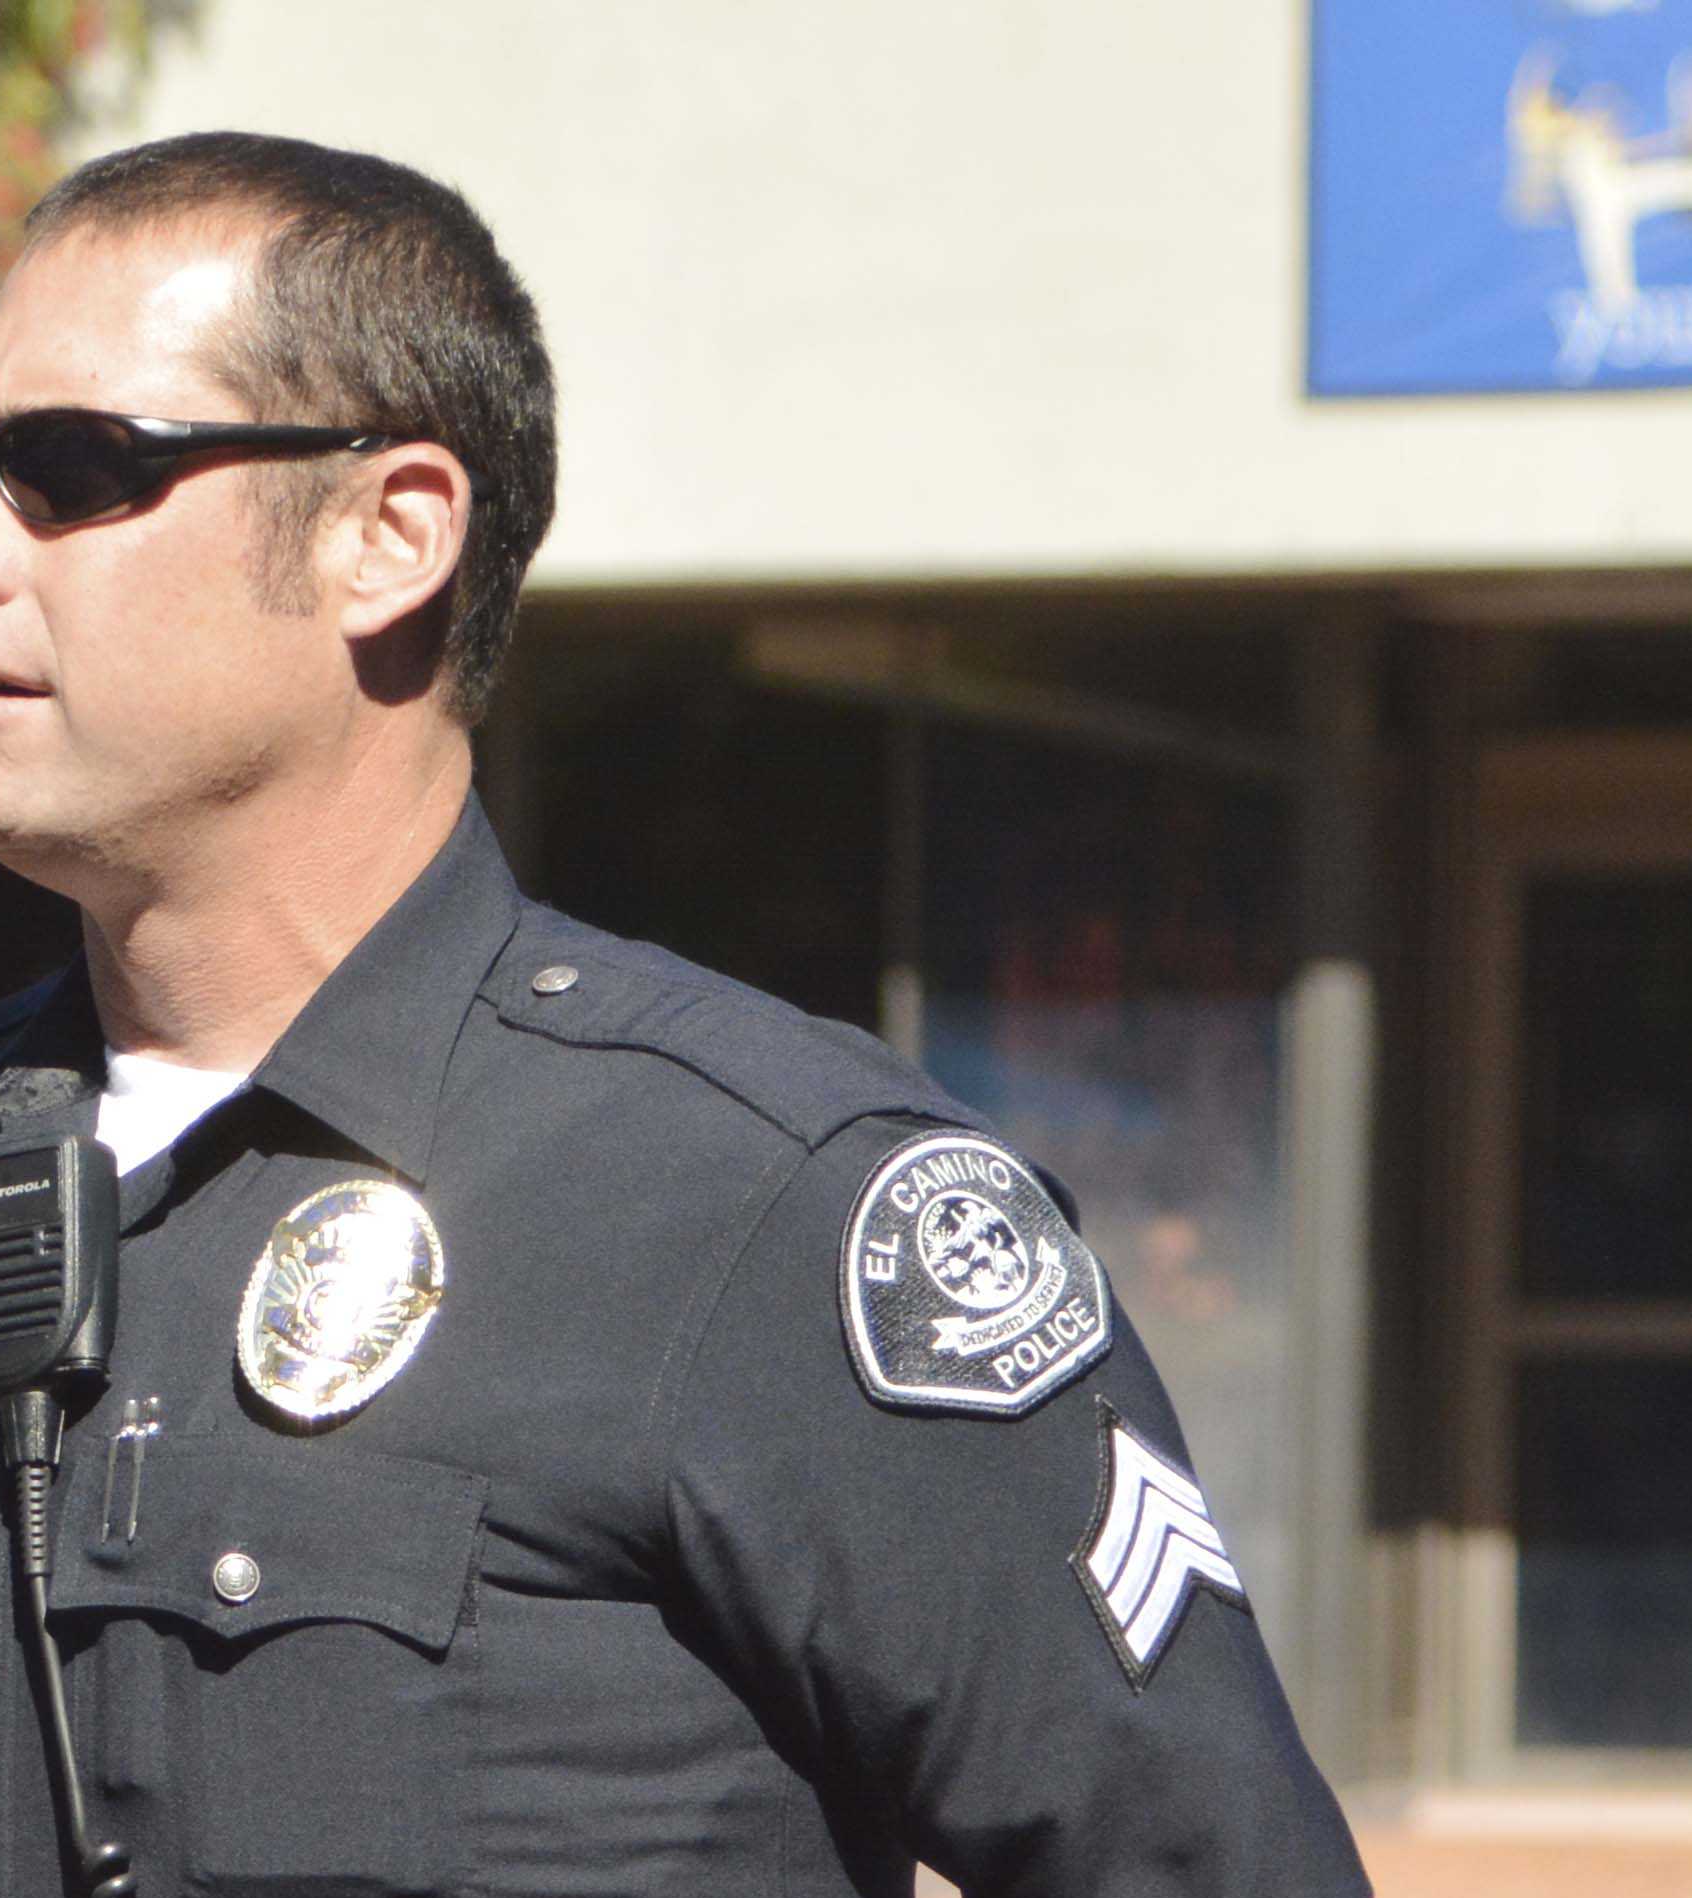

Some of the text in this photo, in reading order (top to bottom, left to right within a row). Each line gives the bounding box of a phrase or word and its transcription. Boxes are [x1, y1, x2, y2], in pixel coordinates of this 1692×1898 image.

[865, 1152, 1011, 1281] EL CAMINO
[960, 1314, 1025, 1347] DEDICATED
[1022, 1303, 1040, 1319] TO
[992, 1297, 1096, 1388] POLICE
